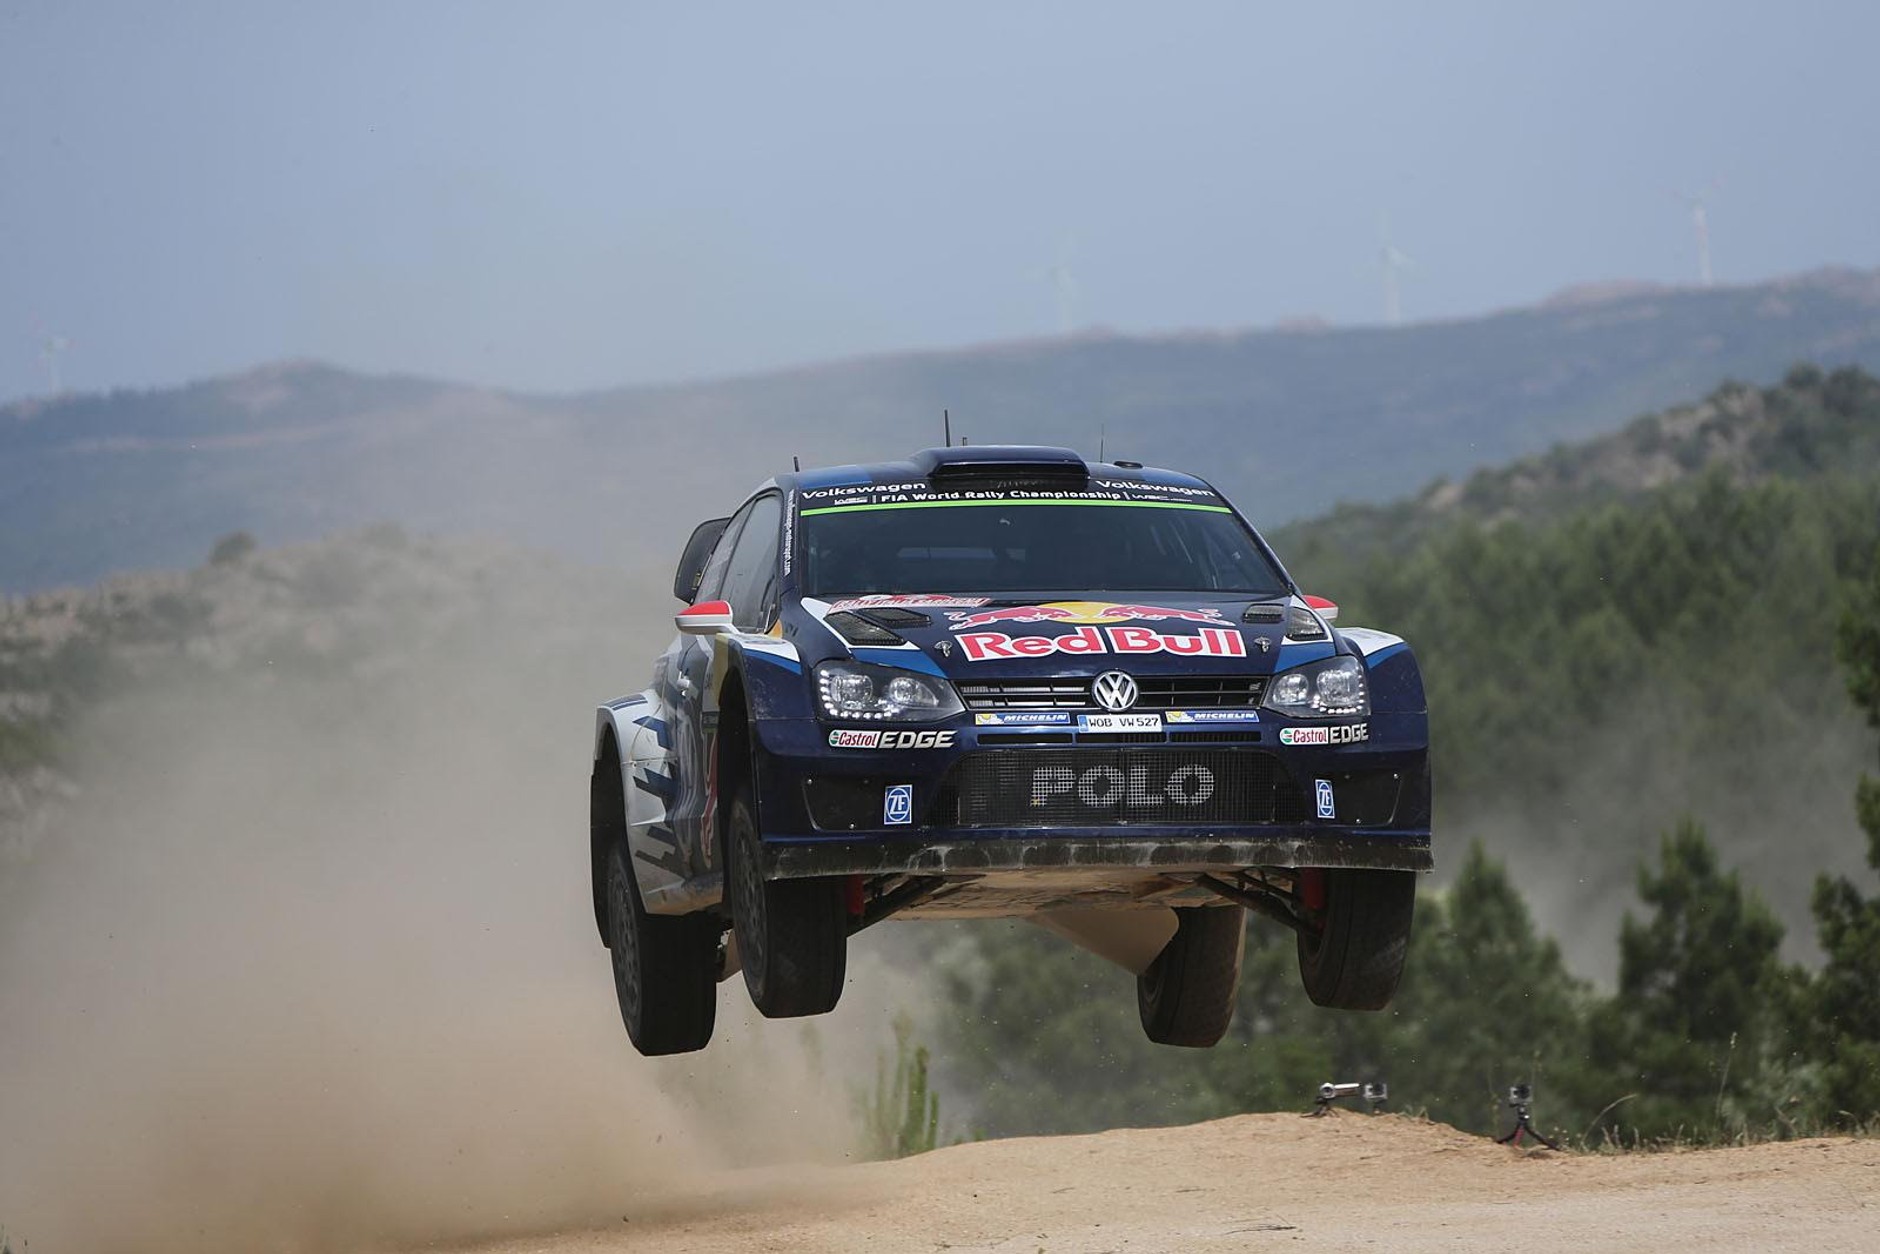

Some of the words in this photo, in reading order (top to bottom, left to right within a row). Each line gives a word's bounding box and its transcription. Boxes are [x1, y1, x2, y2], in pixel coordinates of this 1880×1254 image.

[803, 482, 926, 499] Volkswagen
[881, 494, 908, 502] FIA
[911, 492, 959, 501] World
[965, 490, 1005, 501] Rally
[1010, 490, 1121, 500] Championship
[1096, 480, 1216, 497] Volkswagen
[956, 626, 1103, 661] Red
[1108, 627, 1244, 657] Bull
[1003, 714, 1067, 722] MICHELIN
[1088, 717, 1113, 728] WOB
[1119, 717, 1137, 728] VW
[1137, 717, 1159, 728] 527
[1193, 712, 1255, 721] MICHELIN
[838, 731, 877, 746] Castrol
[878, 730, 958, 749] EDGE
[1293, 729, 1327, 743] Castrol
[1329, 723, 1369, 744] EDGE
[1031, 763, 1215, 808] POLO
[888, 794, 907, 815] ZF
[1319, 789, 1333, 809] ZF
